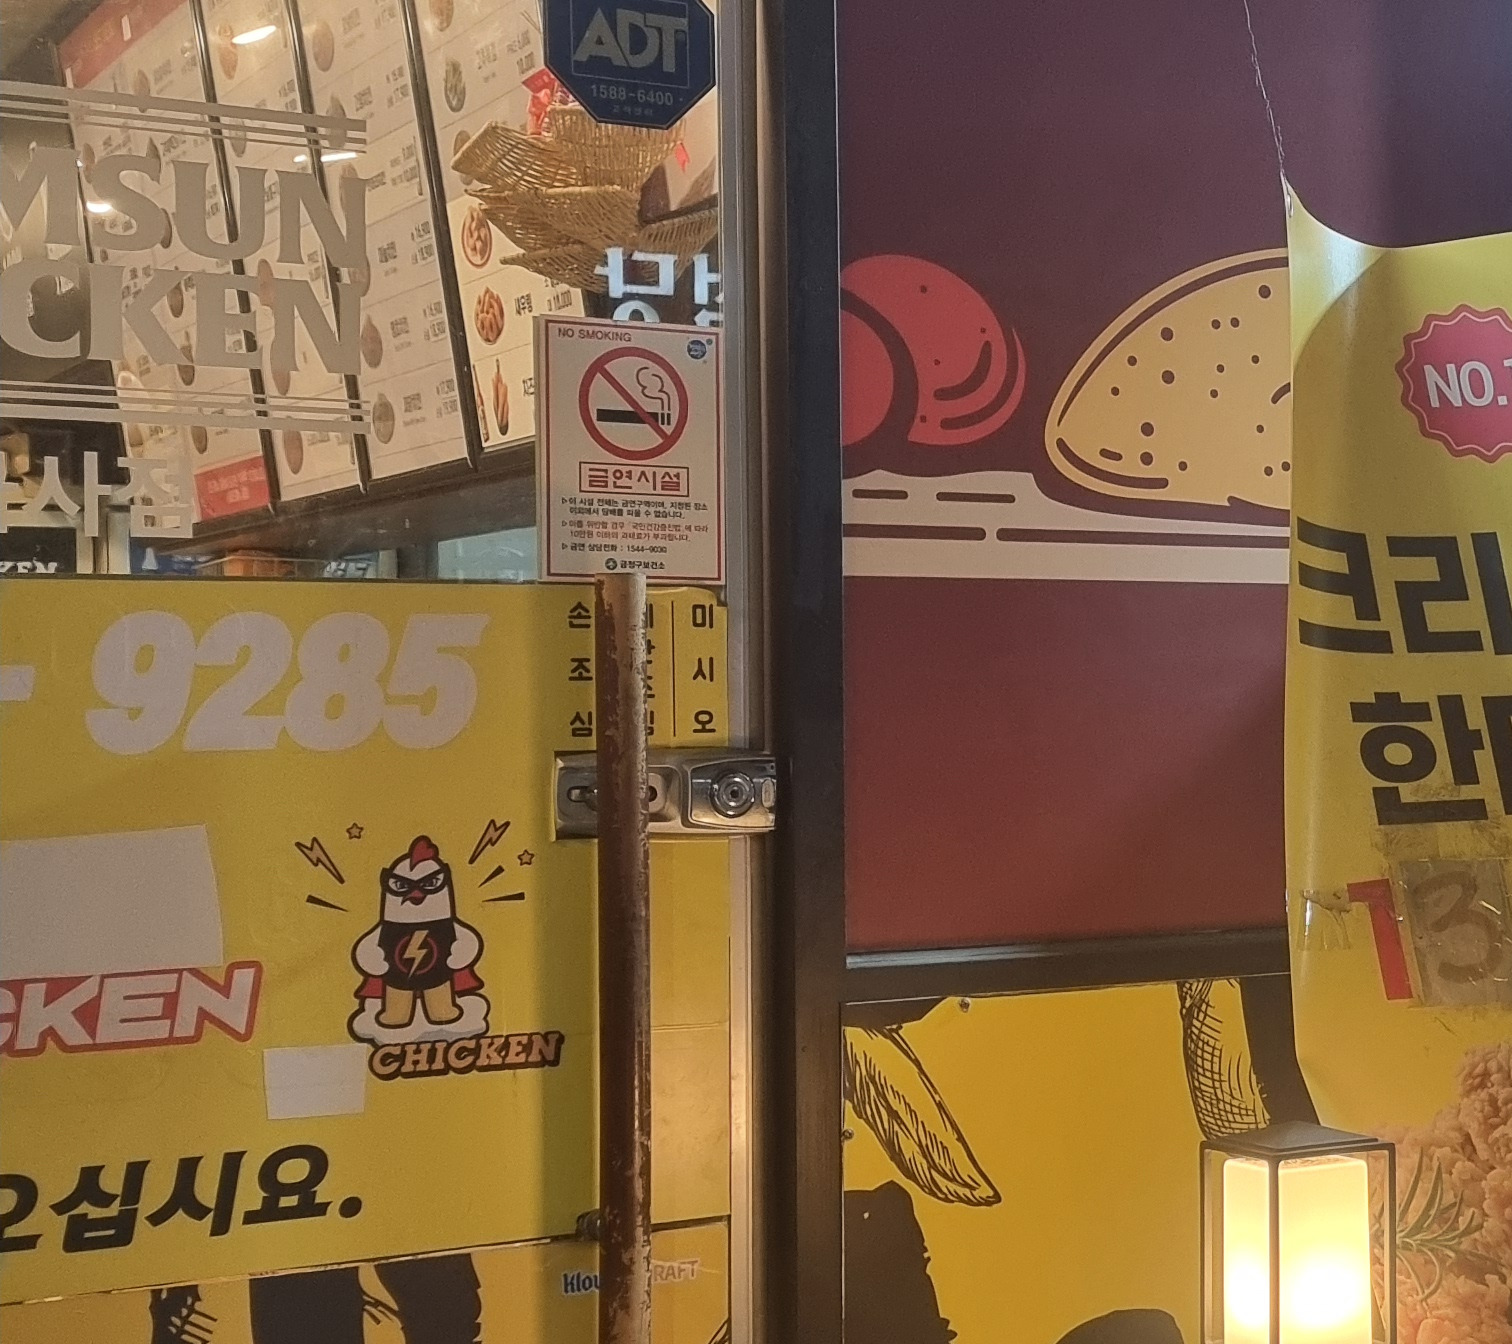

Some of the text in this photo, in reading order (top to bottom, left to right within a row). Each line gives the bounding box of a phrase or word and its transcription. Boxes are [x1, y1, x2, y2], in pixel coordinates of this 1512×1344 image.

[572, 6, 688, 73] ADT
[591, 84, 674, 106] 1588-6400
[557, 327, 633, 343] NO SMOKING
[0, 451, 194, 538] 사점
[587, 467, 681, 492] 금연시설
[85, 610, 489, 755] 9285
[370, 1033, 563, 1077] CHICKEN
